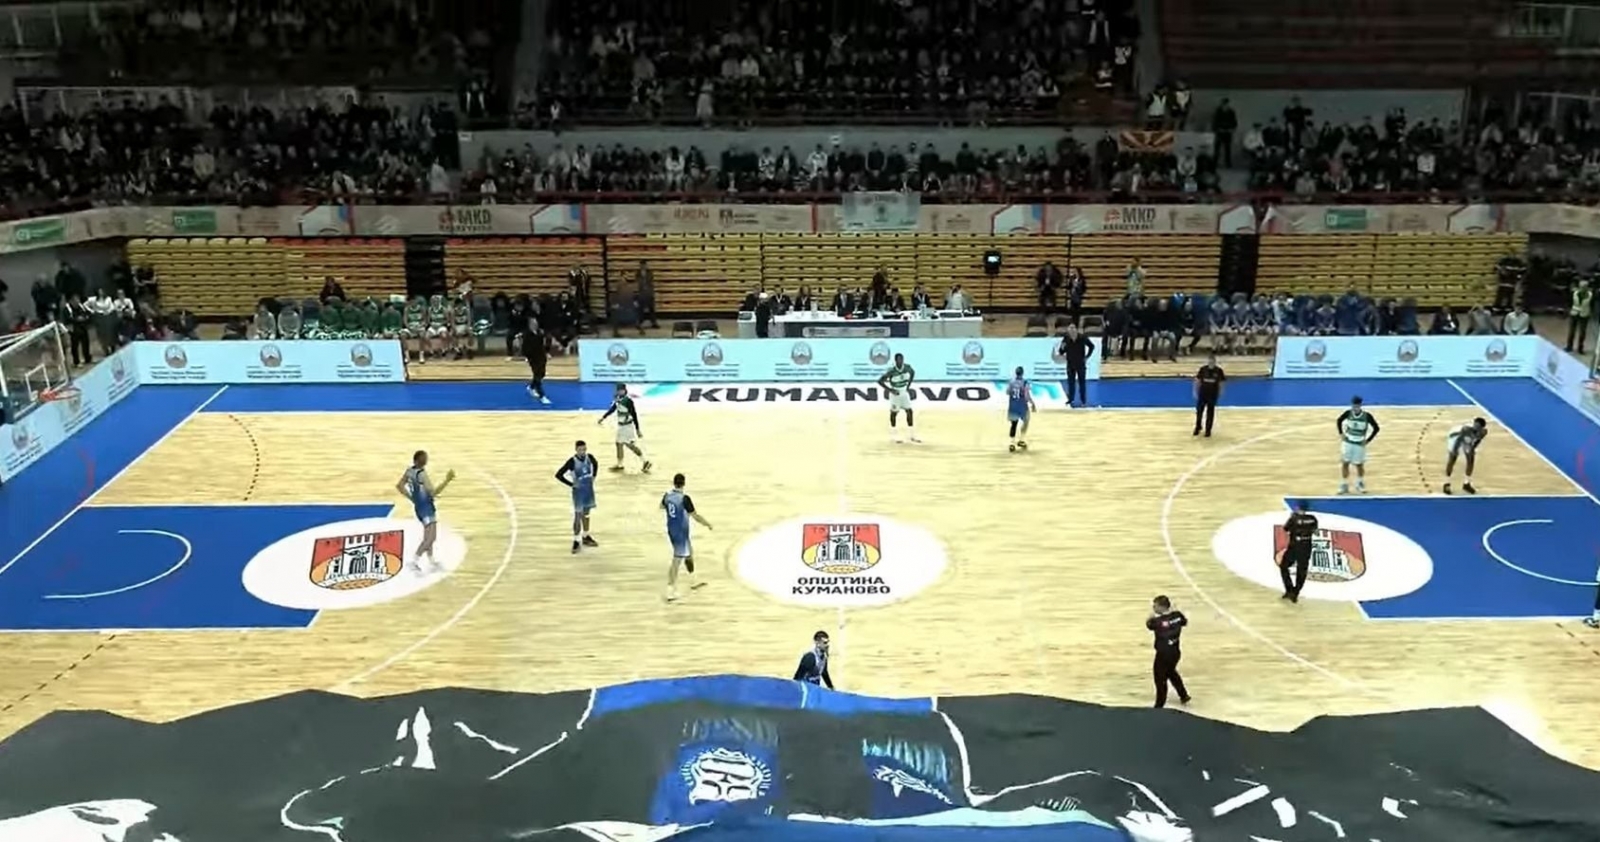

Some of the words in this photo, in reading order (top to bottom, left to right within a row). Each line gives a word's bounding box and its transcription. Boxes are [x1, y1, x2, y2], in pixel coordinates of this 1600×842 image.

[1122, 207, 1156, 223] MKD
[797, 576, 885, 585] ОПШТИНА
[792, 586, 891, 595] КУМАНОВО
